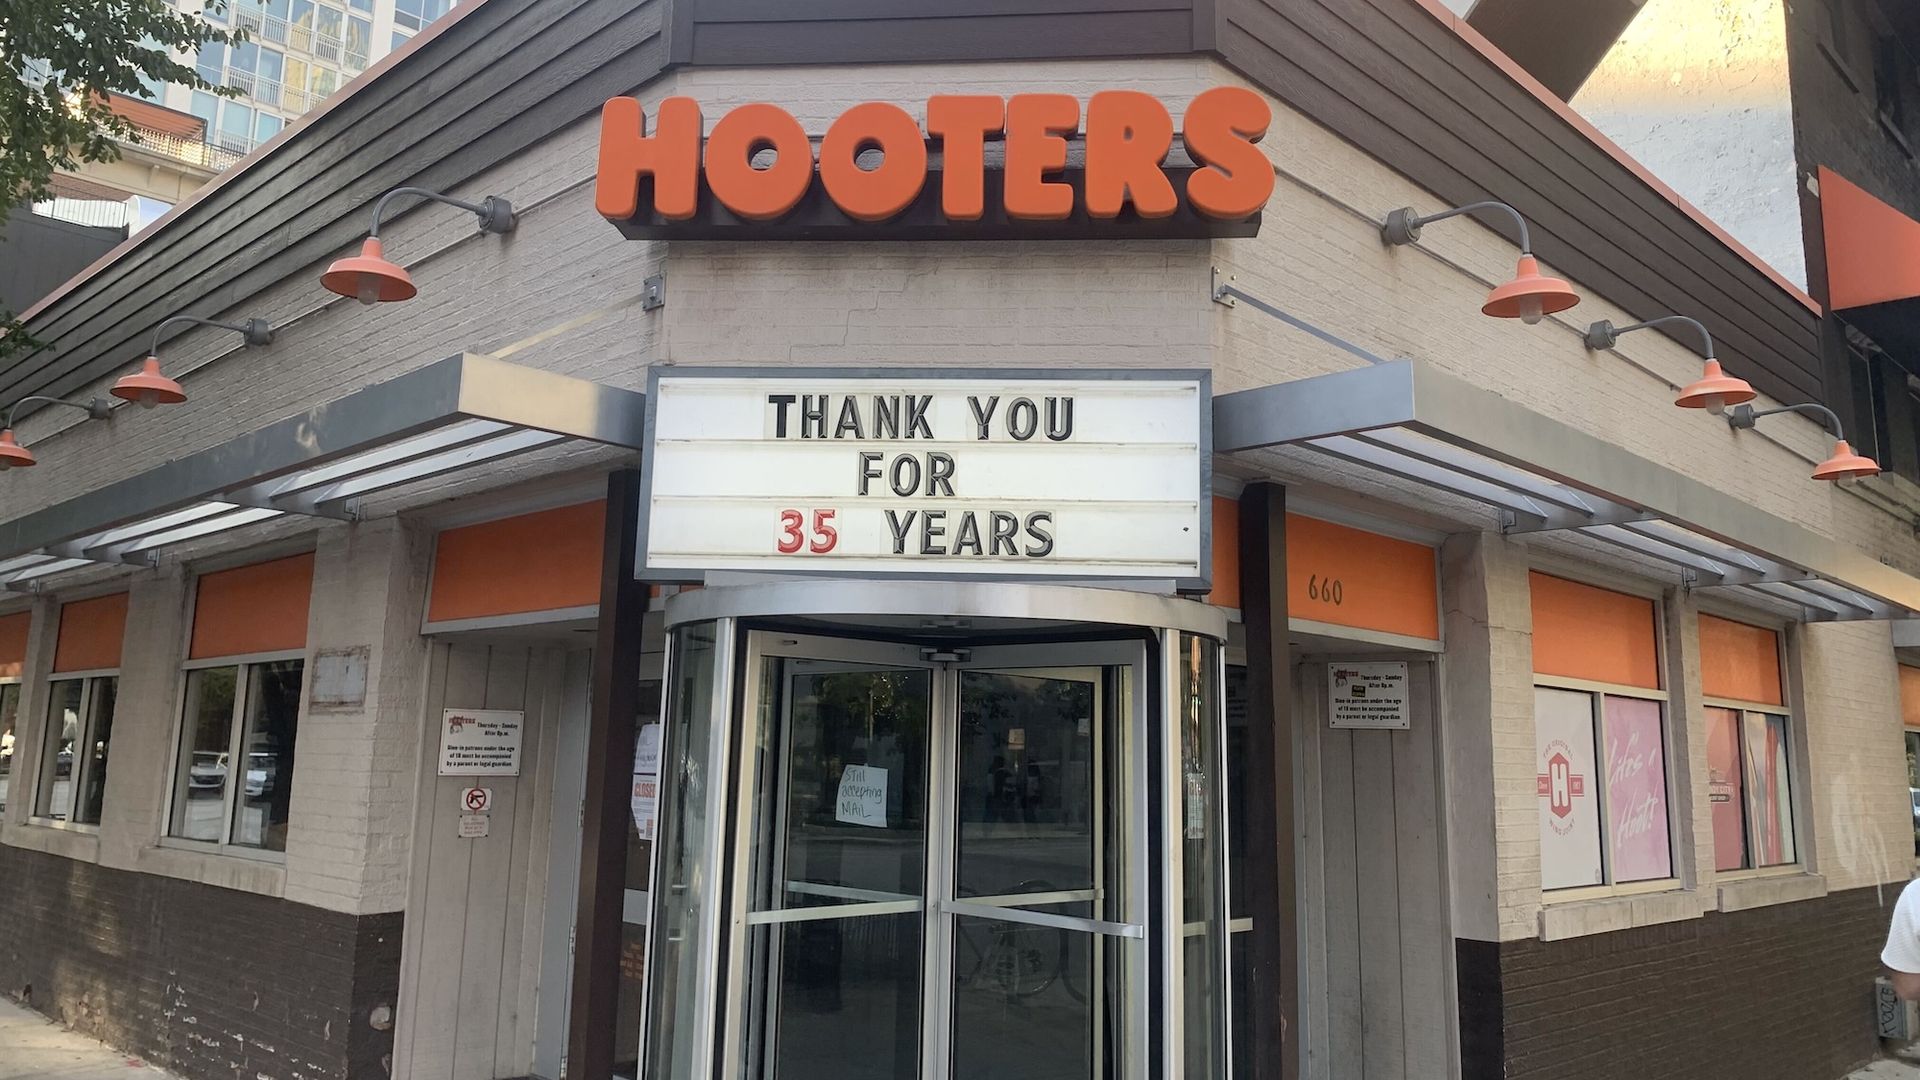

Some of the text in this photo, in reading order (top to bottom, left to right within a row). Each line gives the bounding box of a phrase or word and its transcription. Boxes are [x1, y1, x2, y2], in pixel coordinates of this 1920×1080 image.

[594, 85, 1276, 222] HOOTERS
[768, 394, 1073, 441] THANK YOU
[858, 451, 956, 497] FOR
[778, 509, 1054, 557] 35 YEARS
[1309, 574, 1342, 606] 660
[634, 783, 656, 798] CLOSE
[841, 784, 883, 805] accepting
[1551, 763, 1569, 808] H
